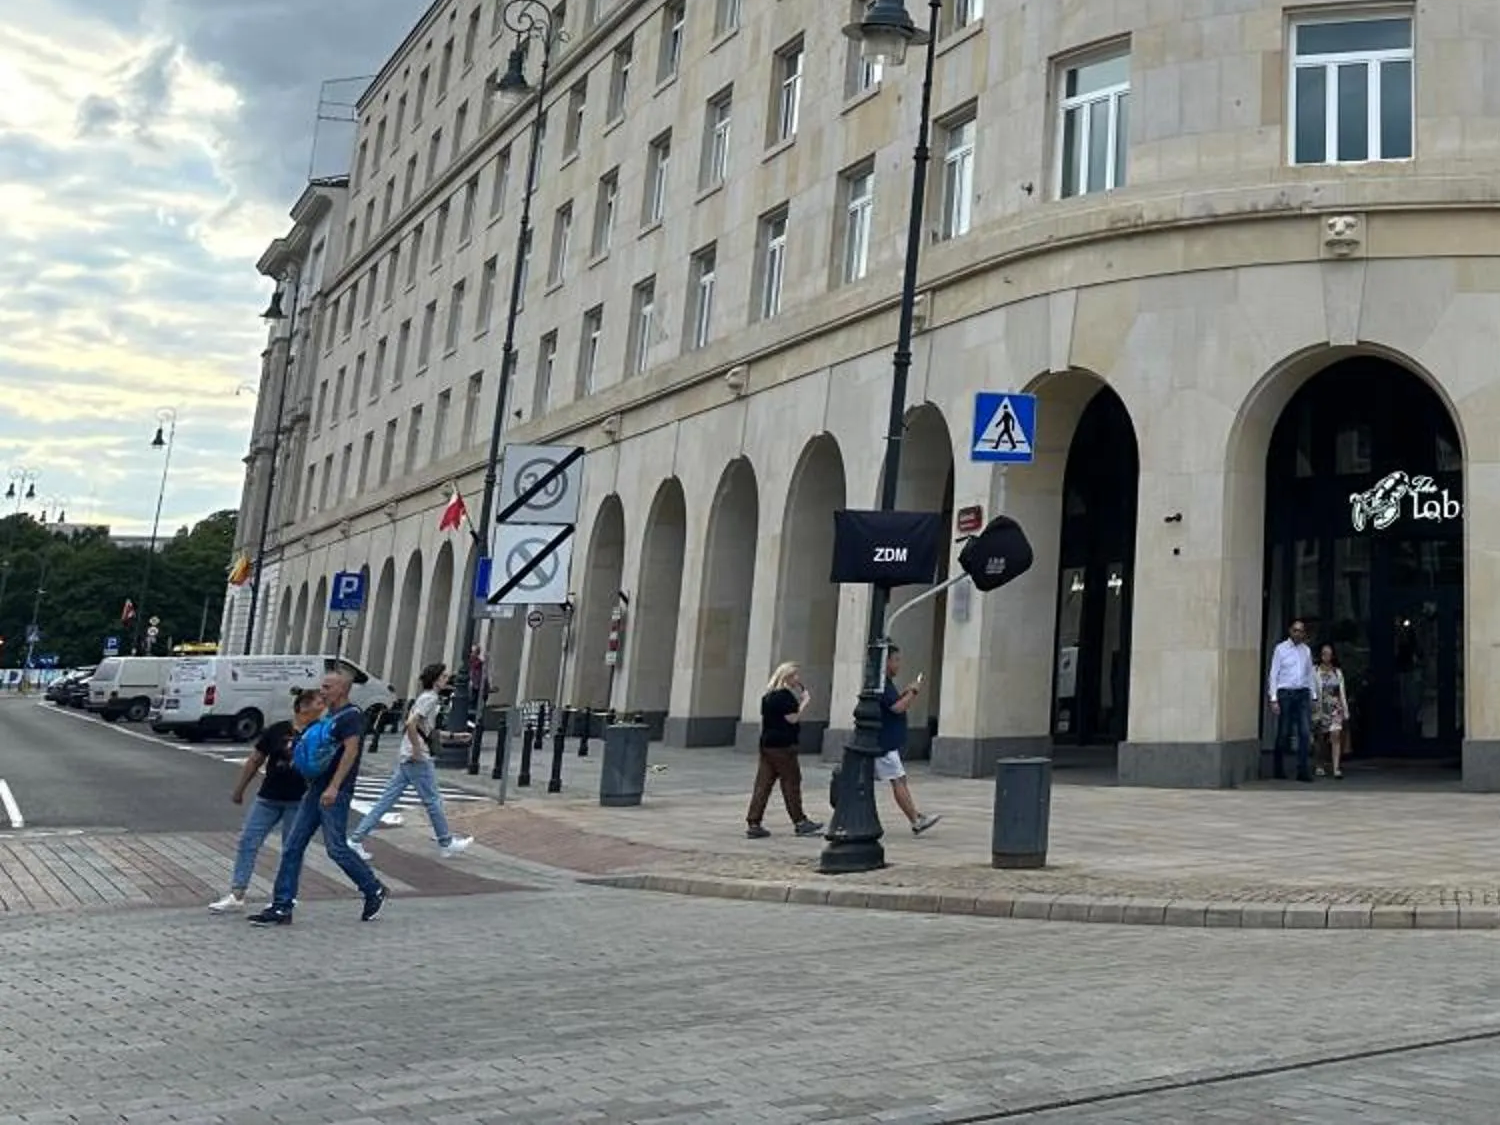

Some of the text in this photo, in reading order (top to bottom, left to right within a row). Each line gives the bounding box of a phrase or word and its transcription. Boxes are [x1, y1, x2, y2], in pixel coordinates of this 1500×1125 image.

[1409, 489, 1463, 523] Lob
[873, 547, 908, 562] ZDM
[339, 576, 360, 599] P
